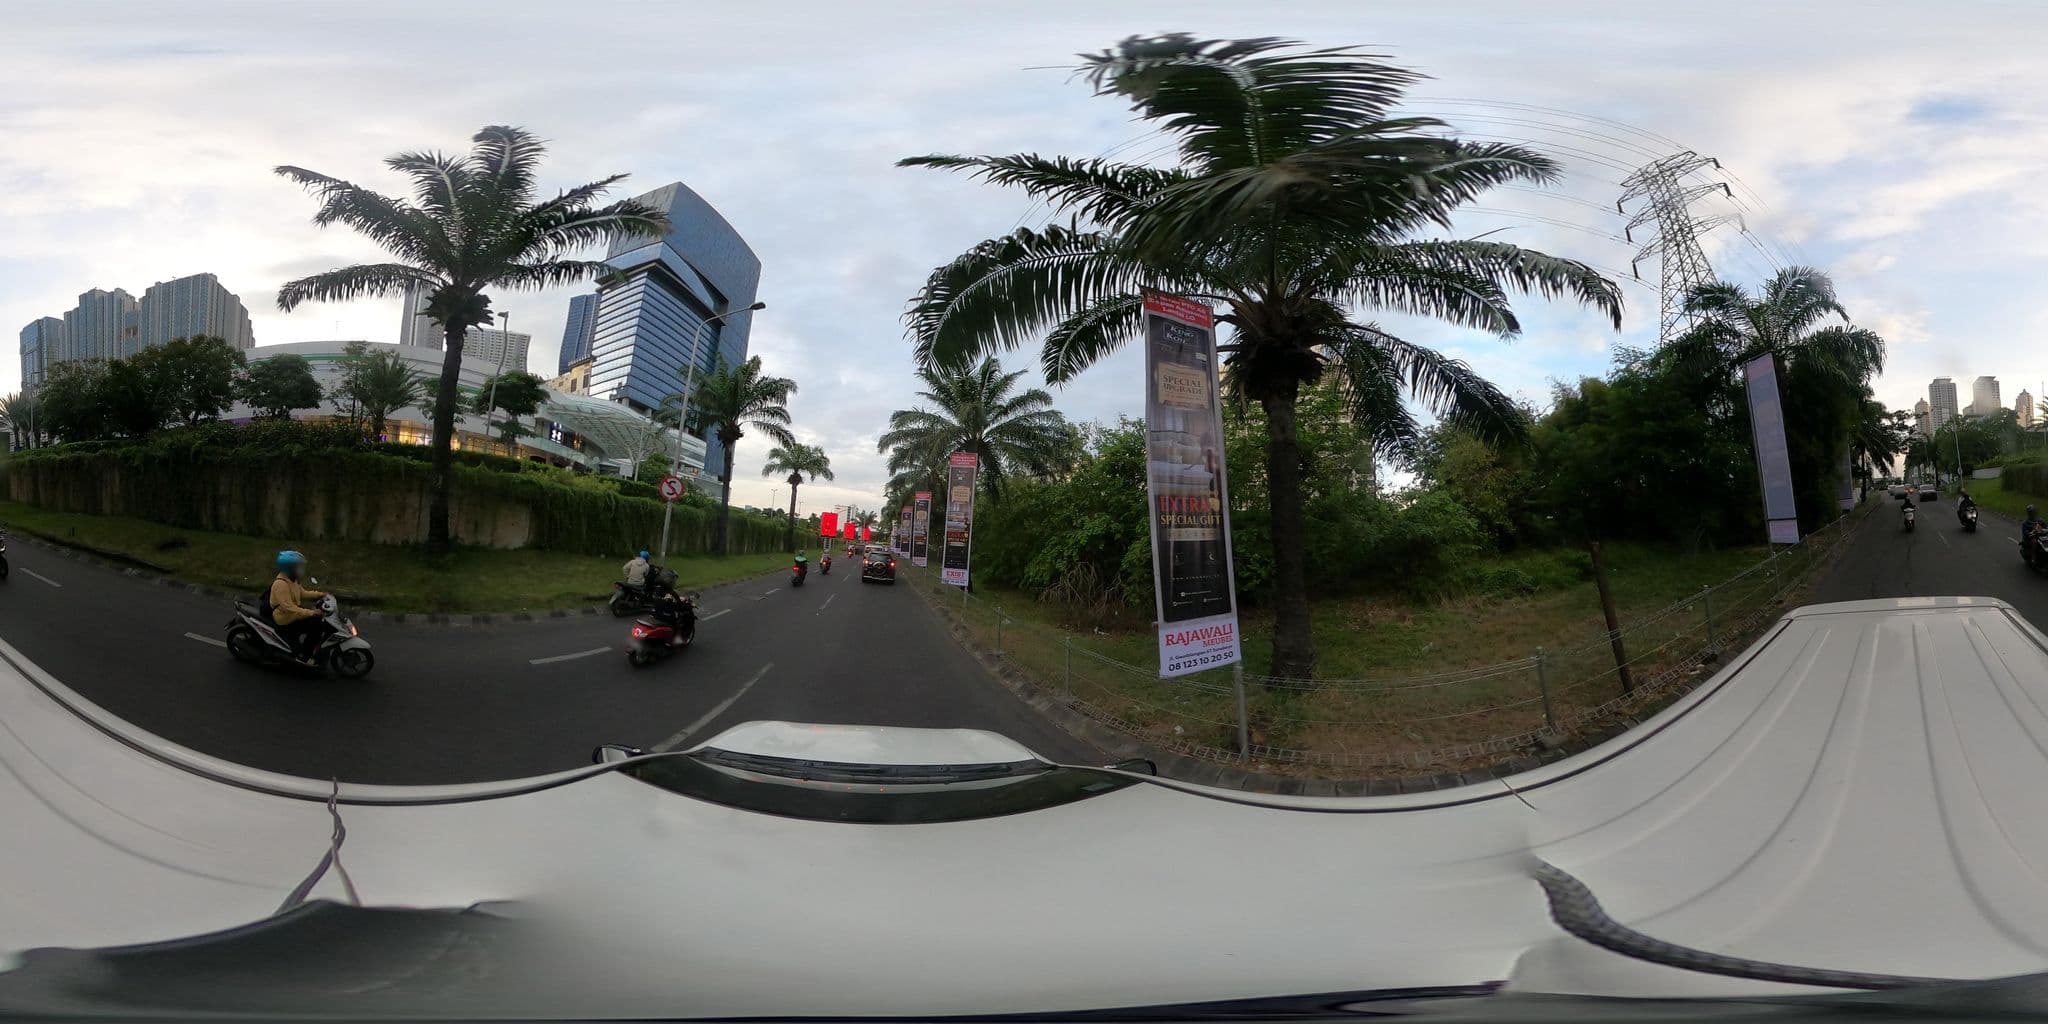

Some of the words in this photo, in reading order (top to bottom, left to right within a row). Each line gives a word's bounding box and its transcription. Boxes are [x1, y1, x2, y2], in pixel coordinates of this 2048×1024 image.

[1163, 374, 1203, 387] SPECIAL
[1159, 495, 1210, 512] EXTRA
[1160, 514, 1198, 525] SPECIAL
[1200, 514, 1220, 525] GIFT
[1165, 623, 1233, 646] RAJAWALI
[1168, 663, 1181, 671] 08
[1183, 659, 1198, 669] 123
[1211, 653, 1222, 663] 20
[1223, 651, 1233, 660] 50
